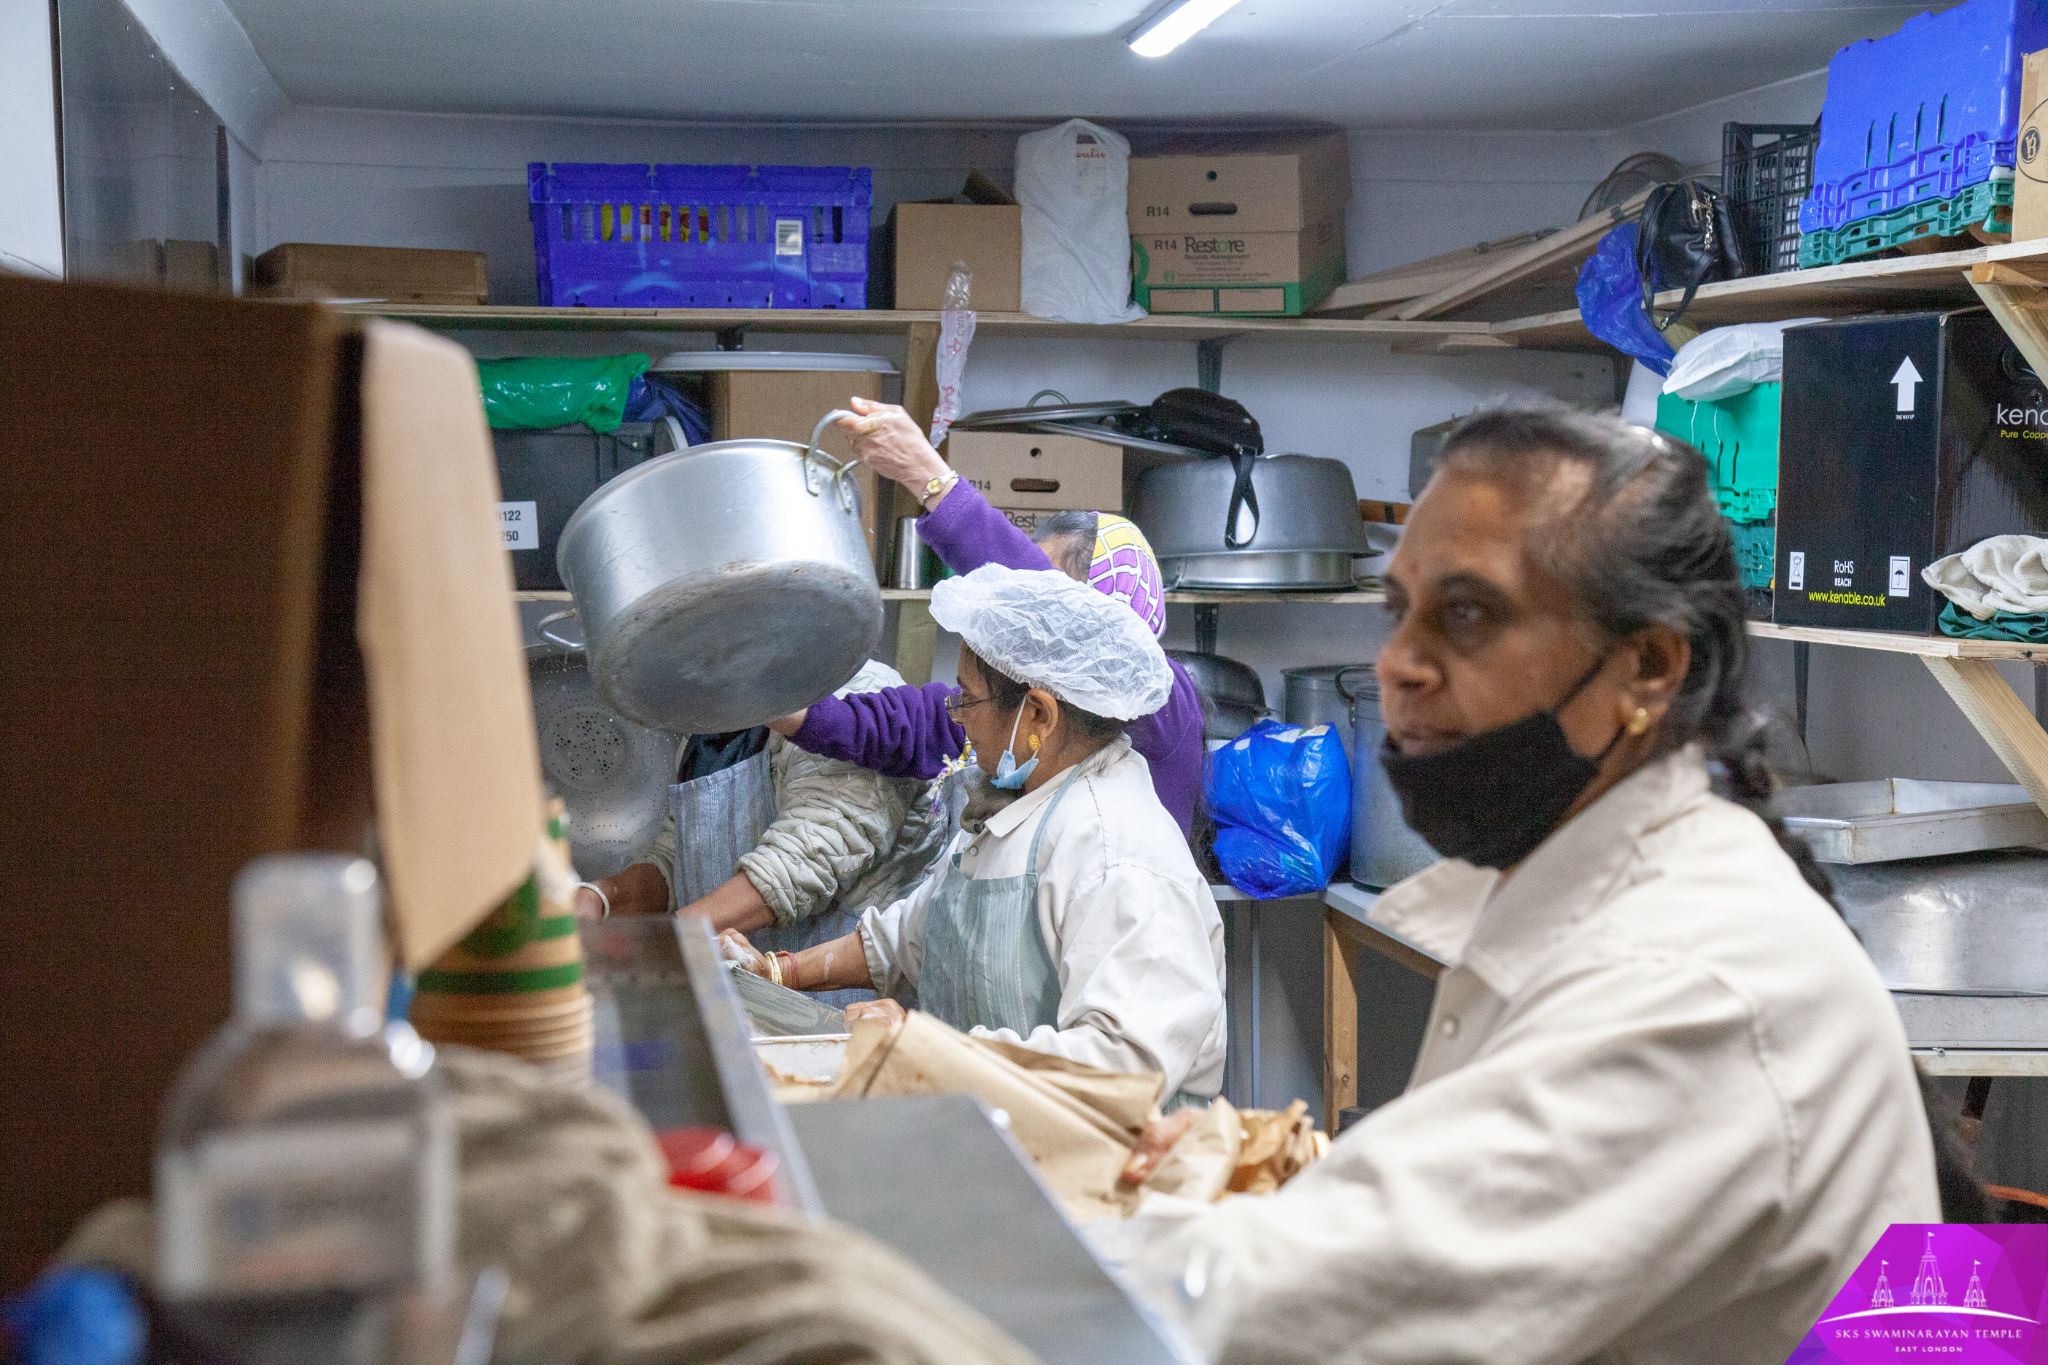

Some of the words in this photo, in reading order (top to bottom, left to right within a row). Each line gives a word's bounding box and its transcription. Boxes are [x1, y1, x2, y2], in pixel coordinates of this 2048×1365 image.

[1146, 206, 1169, 217] R14
[1154, 240, 1177, 250] R14
[1184, 236, 1245, 254] Restore
[2000, 430, 2019, 438] Pure
[2023, 430, 2048, 440] Copp
[1003, 511, 1038, 528] Rest
[1834, 560, 1854, 574] RoHS
[1834, 578, 1852, 587] REACH
[1808, 590, 1886, 607] www.kenable.co.uk
